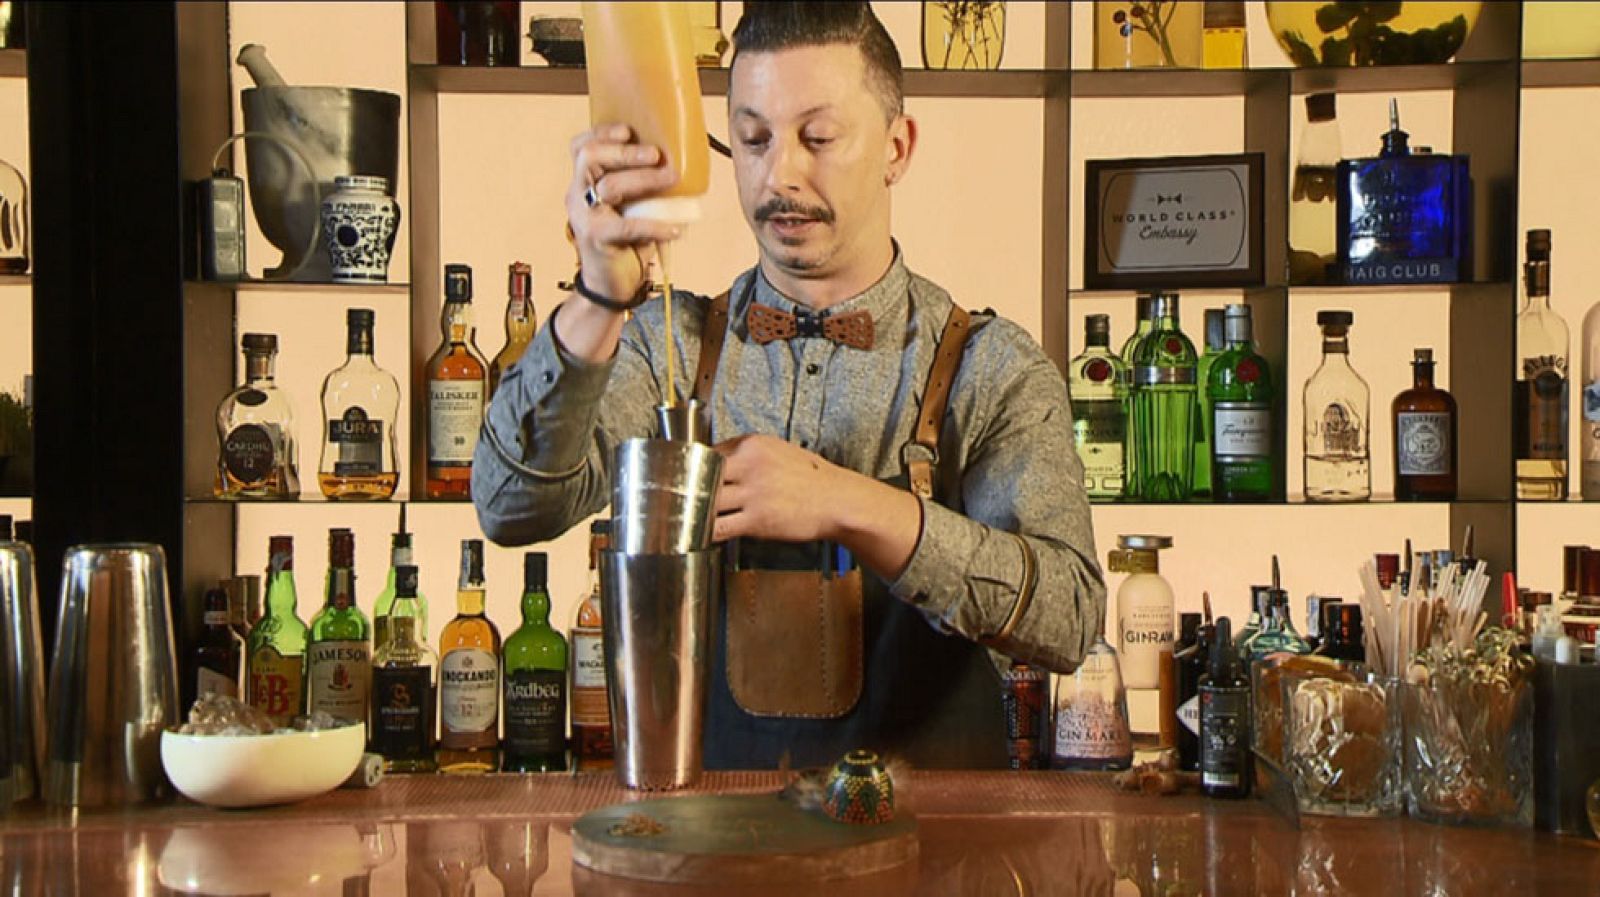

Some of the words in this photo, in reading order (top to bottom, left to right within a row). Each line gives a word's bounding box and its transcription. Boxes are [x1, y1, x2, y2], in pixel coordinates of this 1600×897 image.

[1112, 212, 1168, 223] WORLD
[1175, 209, 1227, 221] CLASS
[1139, 224, 1197, 245] Embassy
[1347, 266, 1386, 279] HAIG
[1391, 263, 1440, 278] CLUB
[336, 421, 381, 434] JURA
[311, 647, 367, 665] JAMESON
[1058, 730, 1081, 741] GIN
